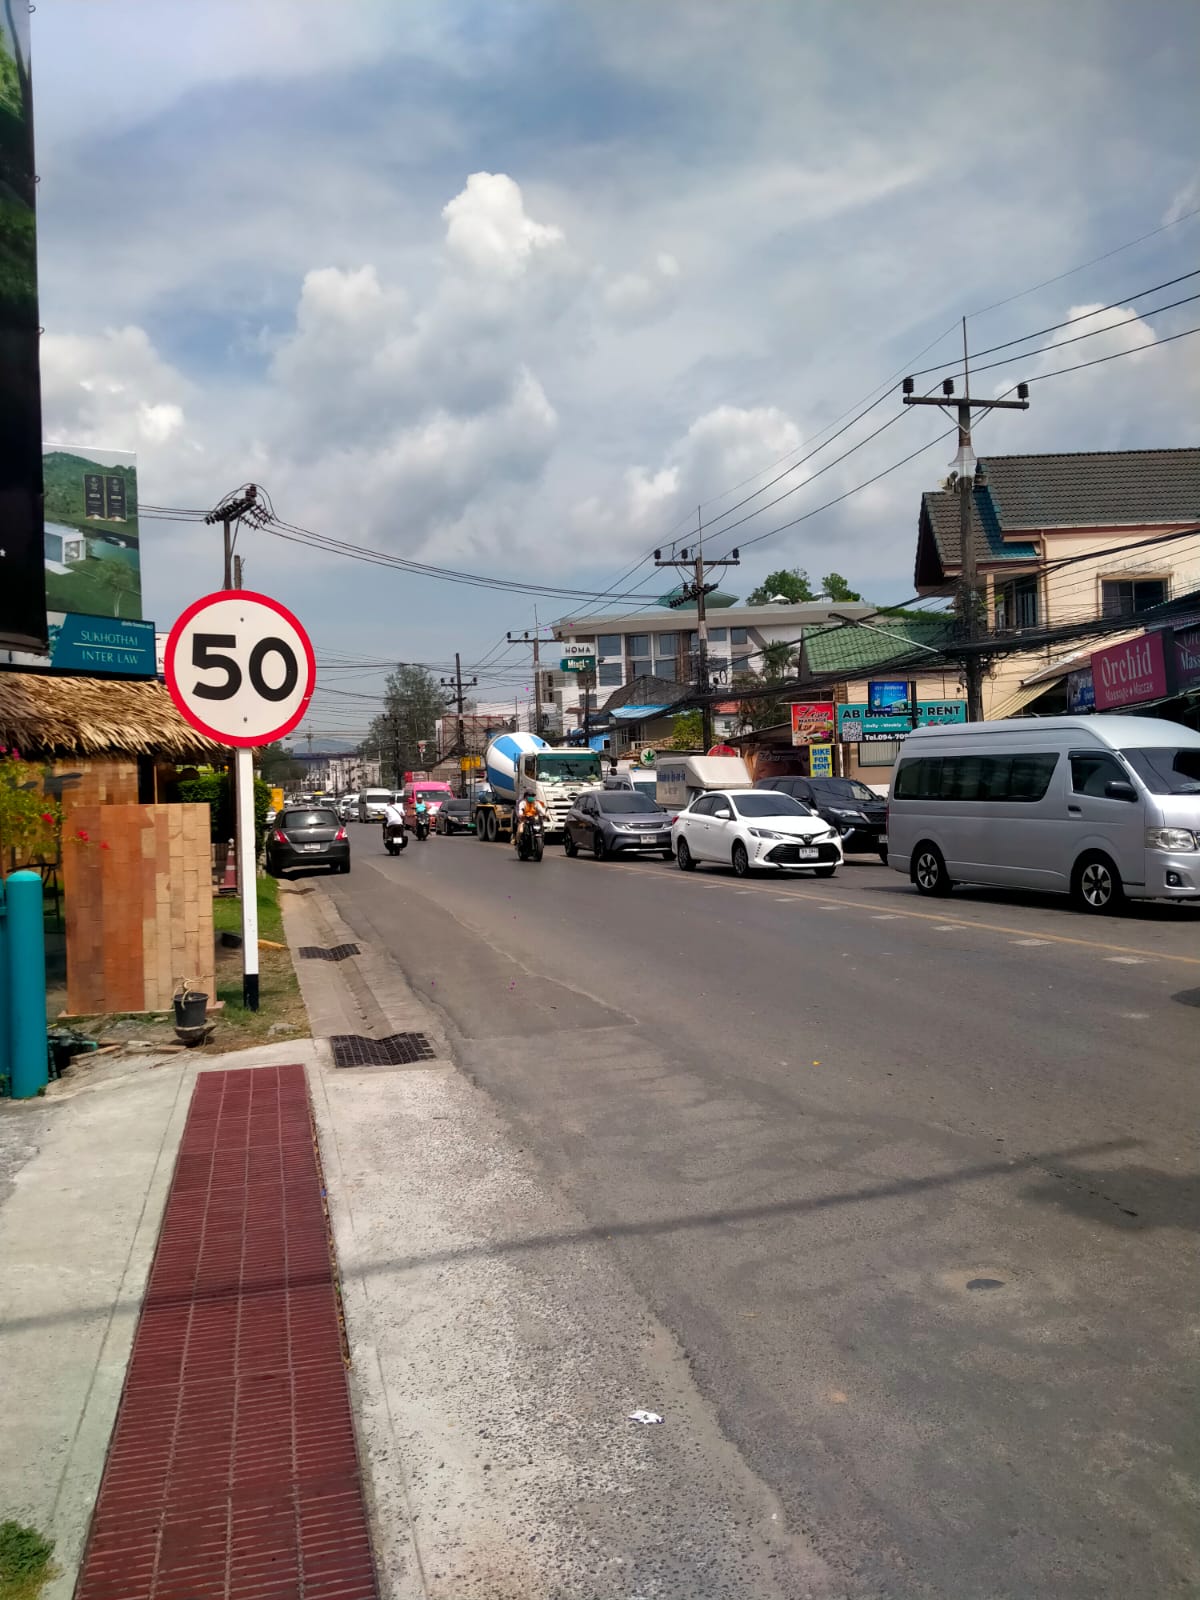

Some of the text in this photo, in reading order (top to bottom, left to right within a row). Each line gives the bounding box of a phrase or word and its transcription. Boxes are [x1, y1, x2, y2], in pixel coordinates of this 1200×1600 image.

[80, 630, 138, 646] SUKHOTHAI
[82, 650, 138, 664] INTER LAW
[565, 646, 591, 654] HOMA
[192, 633, 299, 702] 50
[1101, 642, 1153, 688] Orchid
[842, 709, 861, 719] AB
[927, 705, 960, 716] RENT
